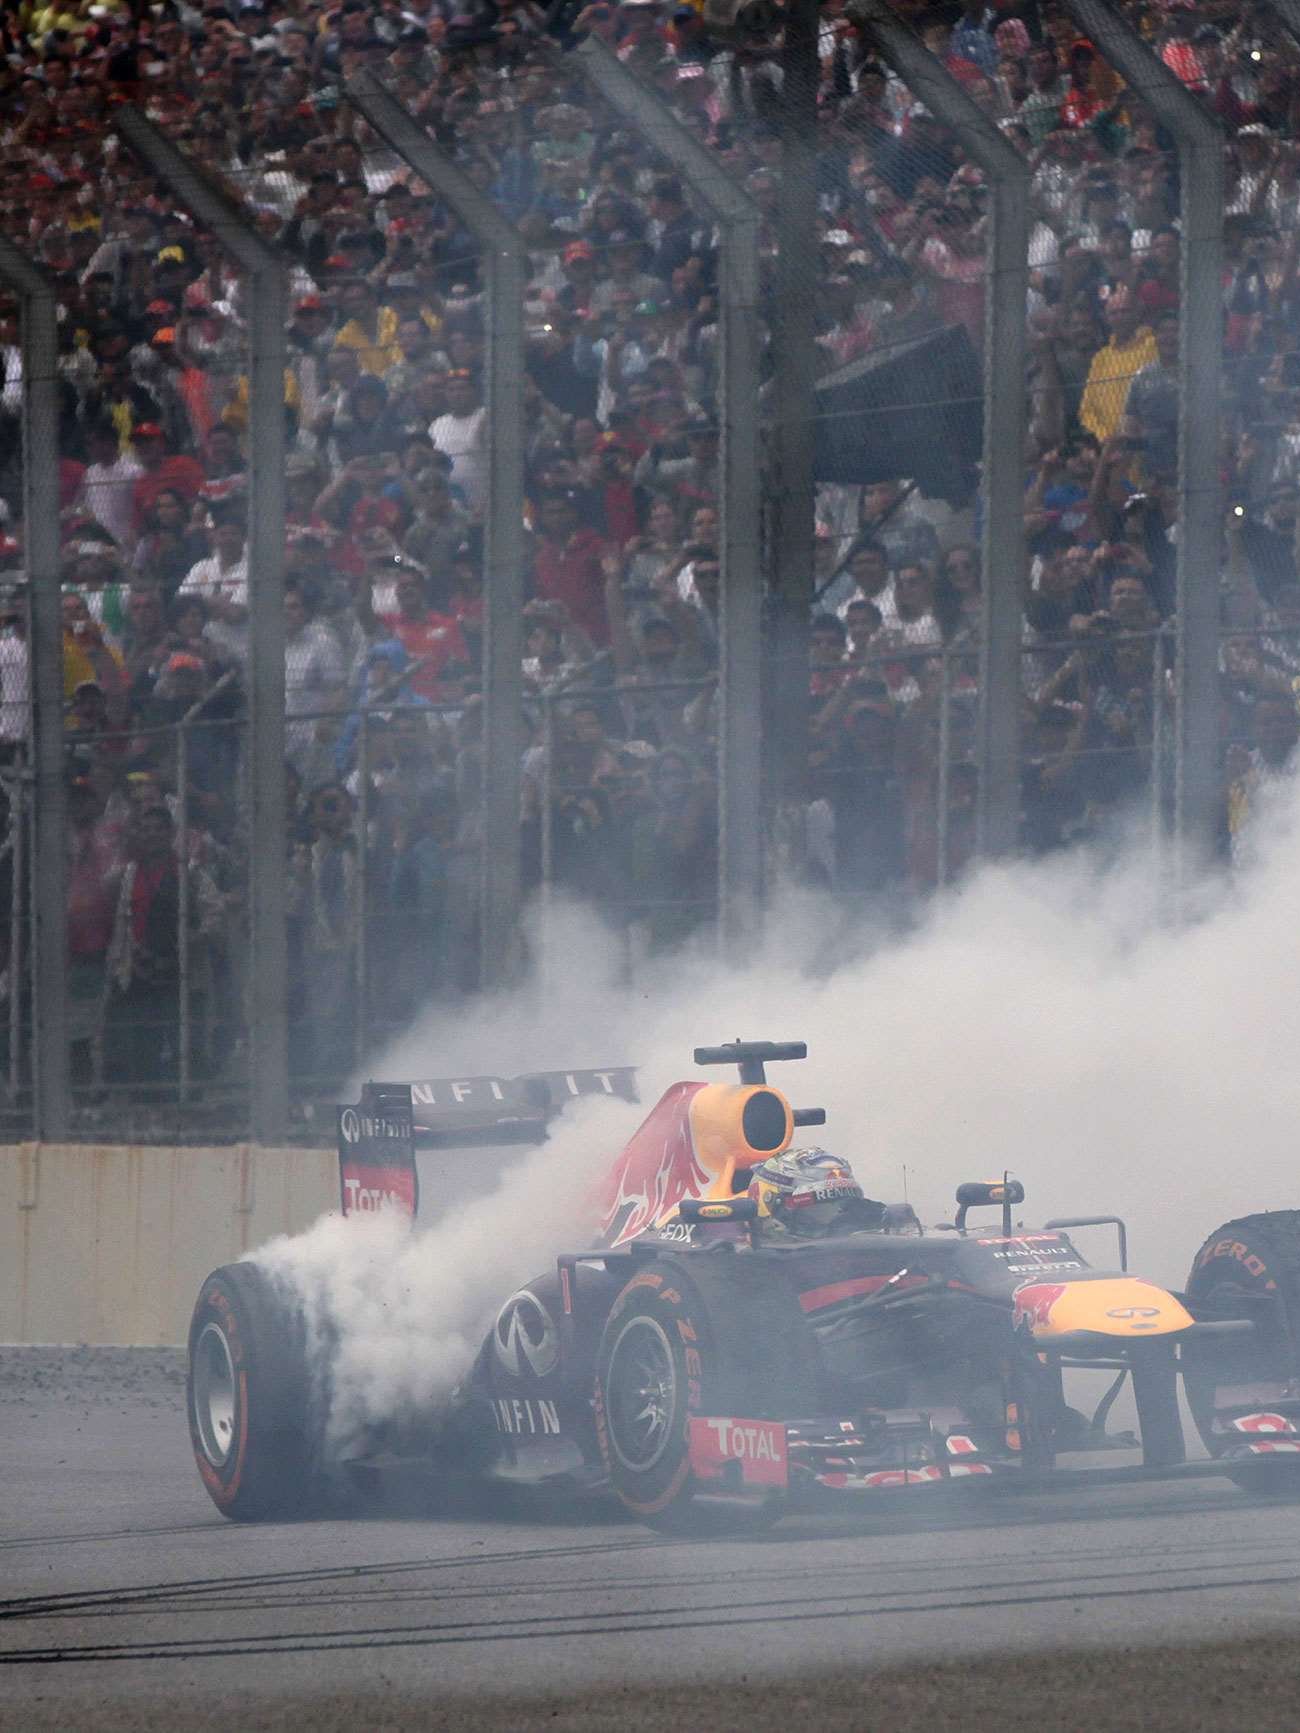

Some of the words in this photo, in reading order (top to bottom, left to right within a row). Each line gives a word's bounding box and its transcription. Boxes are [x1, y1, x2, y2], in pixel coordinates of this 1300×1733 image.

[658, 1223, 697, 1243] GEOX
[993, 1247, 1068, 1259] RENAULT
[707, 1419, 781, 1463] TOTAL
